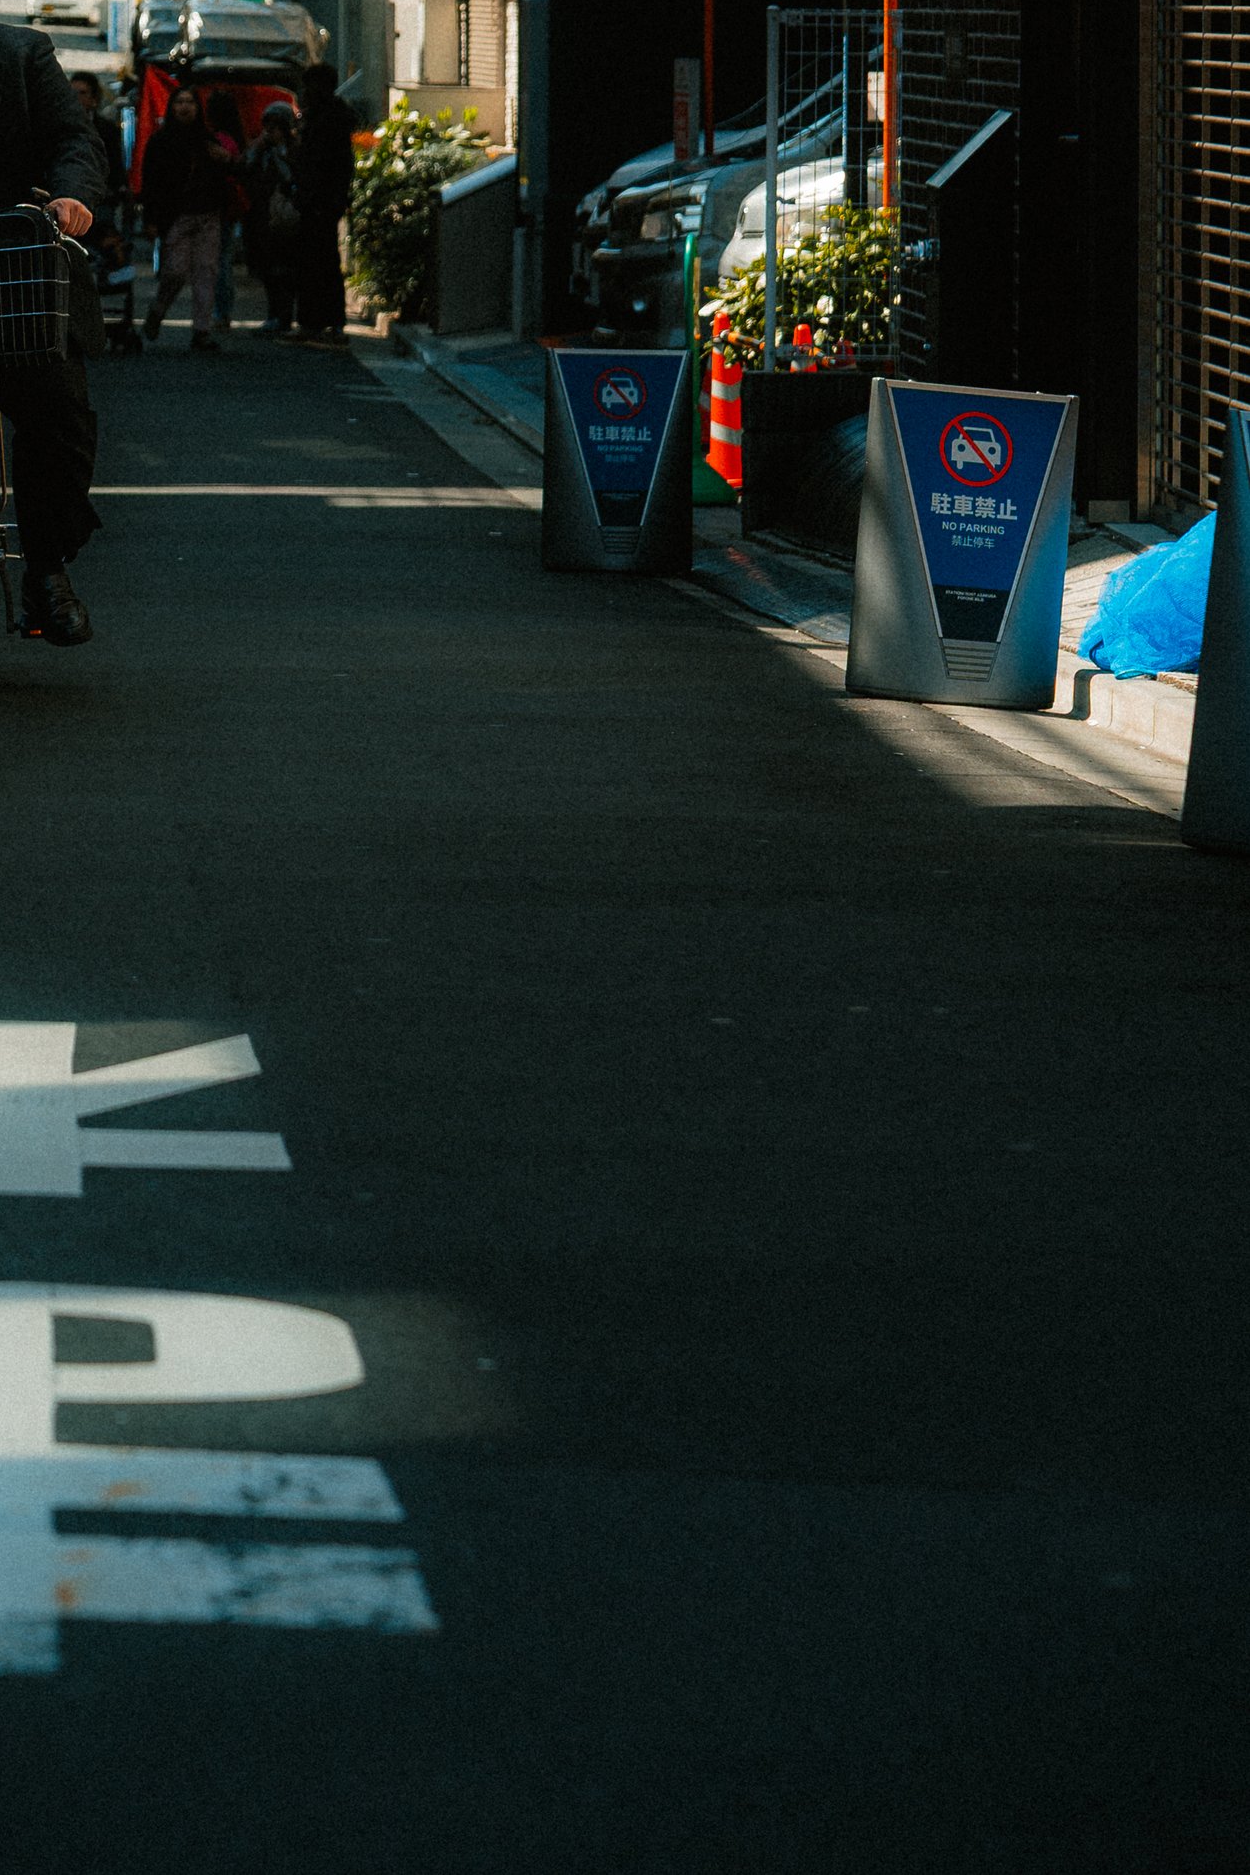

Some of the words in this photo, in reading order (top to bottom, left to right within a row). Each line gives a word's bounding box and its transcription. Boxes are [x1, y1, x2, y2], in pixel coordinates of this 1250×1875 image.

[589, 425, 652, 441] 駐車禁止
[597, 444, 607, 452] NO
[609, 444, 643, 452] PARKING
[931, 492, 1018, 520] 駐車禁止
[942, 521, 957, 531] NO
[959, 522, 1005, 534] PARKING
[951, 535, 995, 548] 禁止停车
